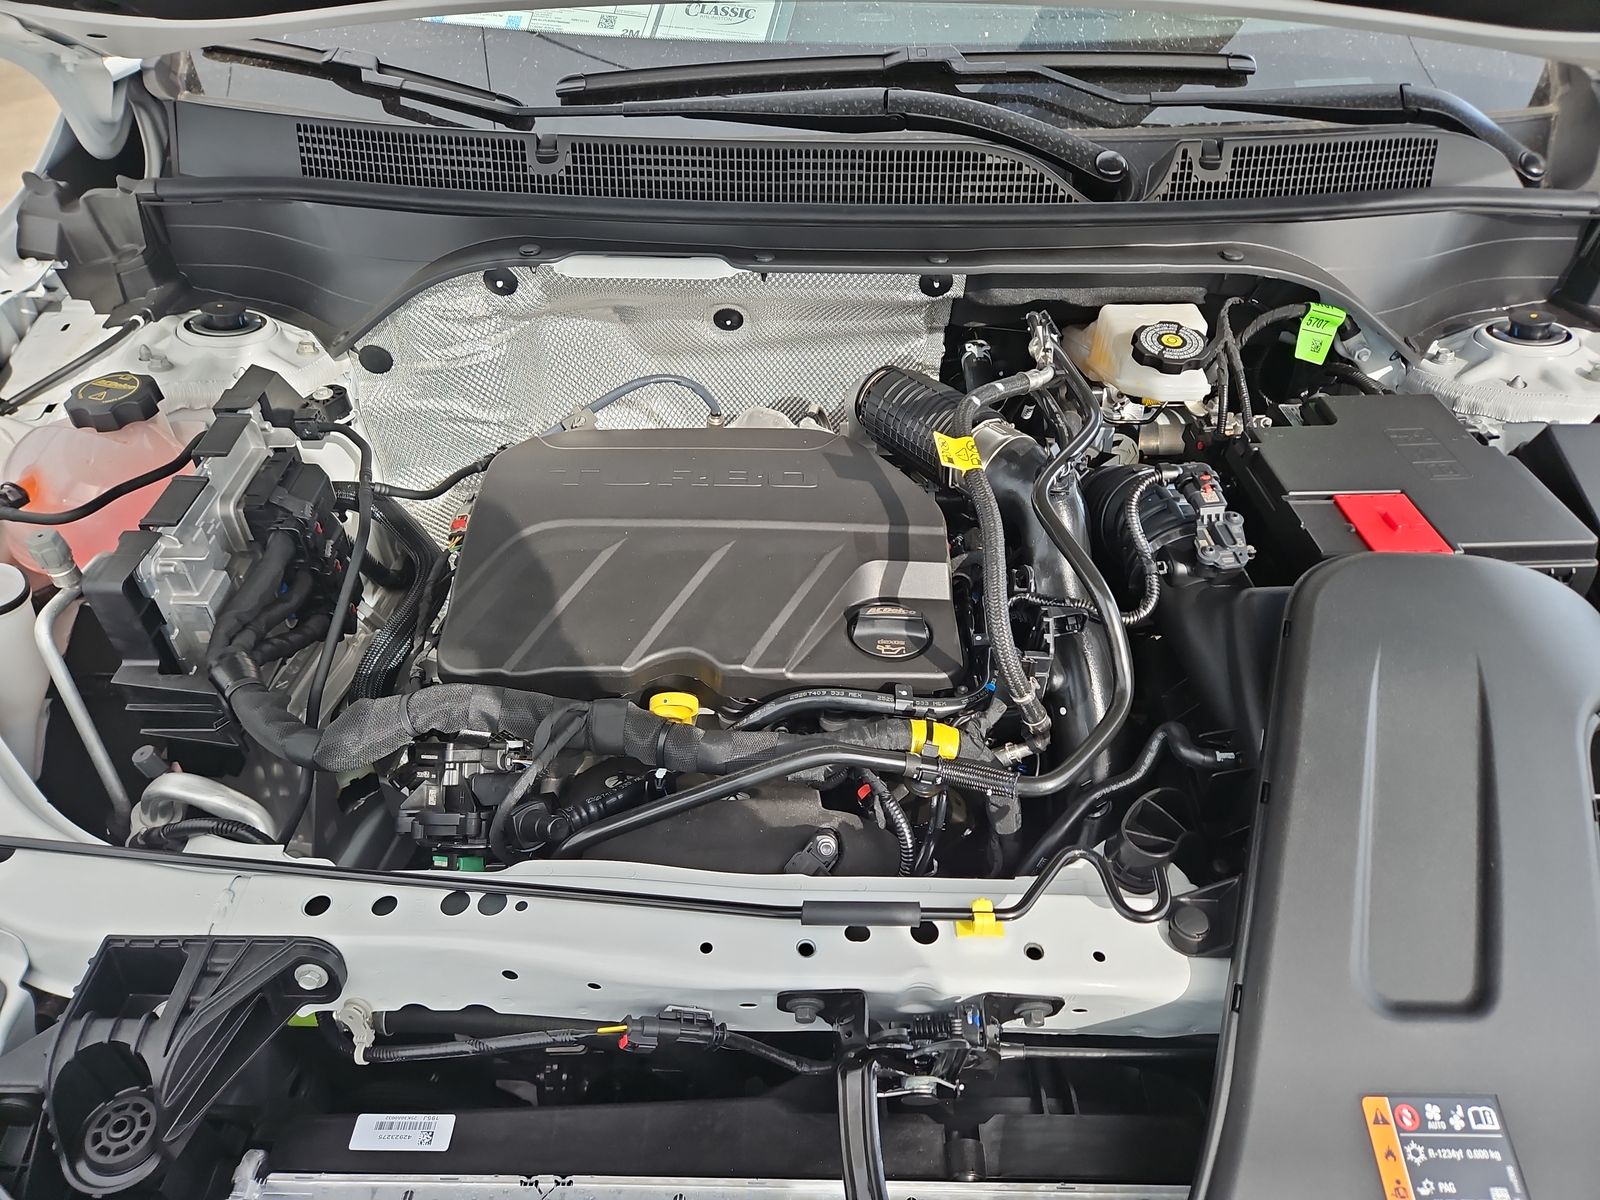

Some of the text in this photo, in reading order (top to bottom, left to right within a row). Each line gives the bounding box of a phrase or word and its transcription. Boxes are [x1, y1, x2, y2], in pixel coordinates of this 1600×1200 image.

[684, 3, 757, 19] CLASSIC
[1306, 316, 1330, 330] 5707
[547, 468, 820, 489] TURBO
[866, 607, 917, 615] ACDelco
[1427, 1120, 1447, 1130] AUTO
[1437, 1181, 1457, 1194] PAG
